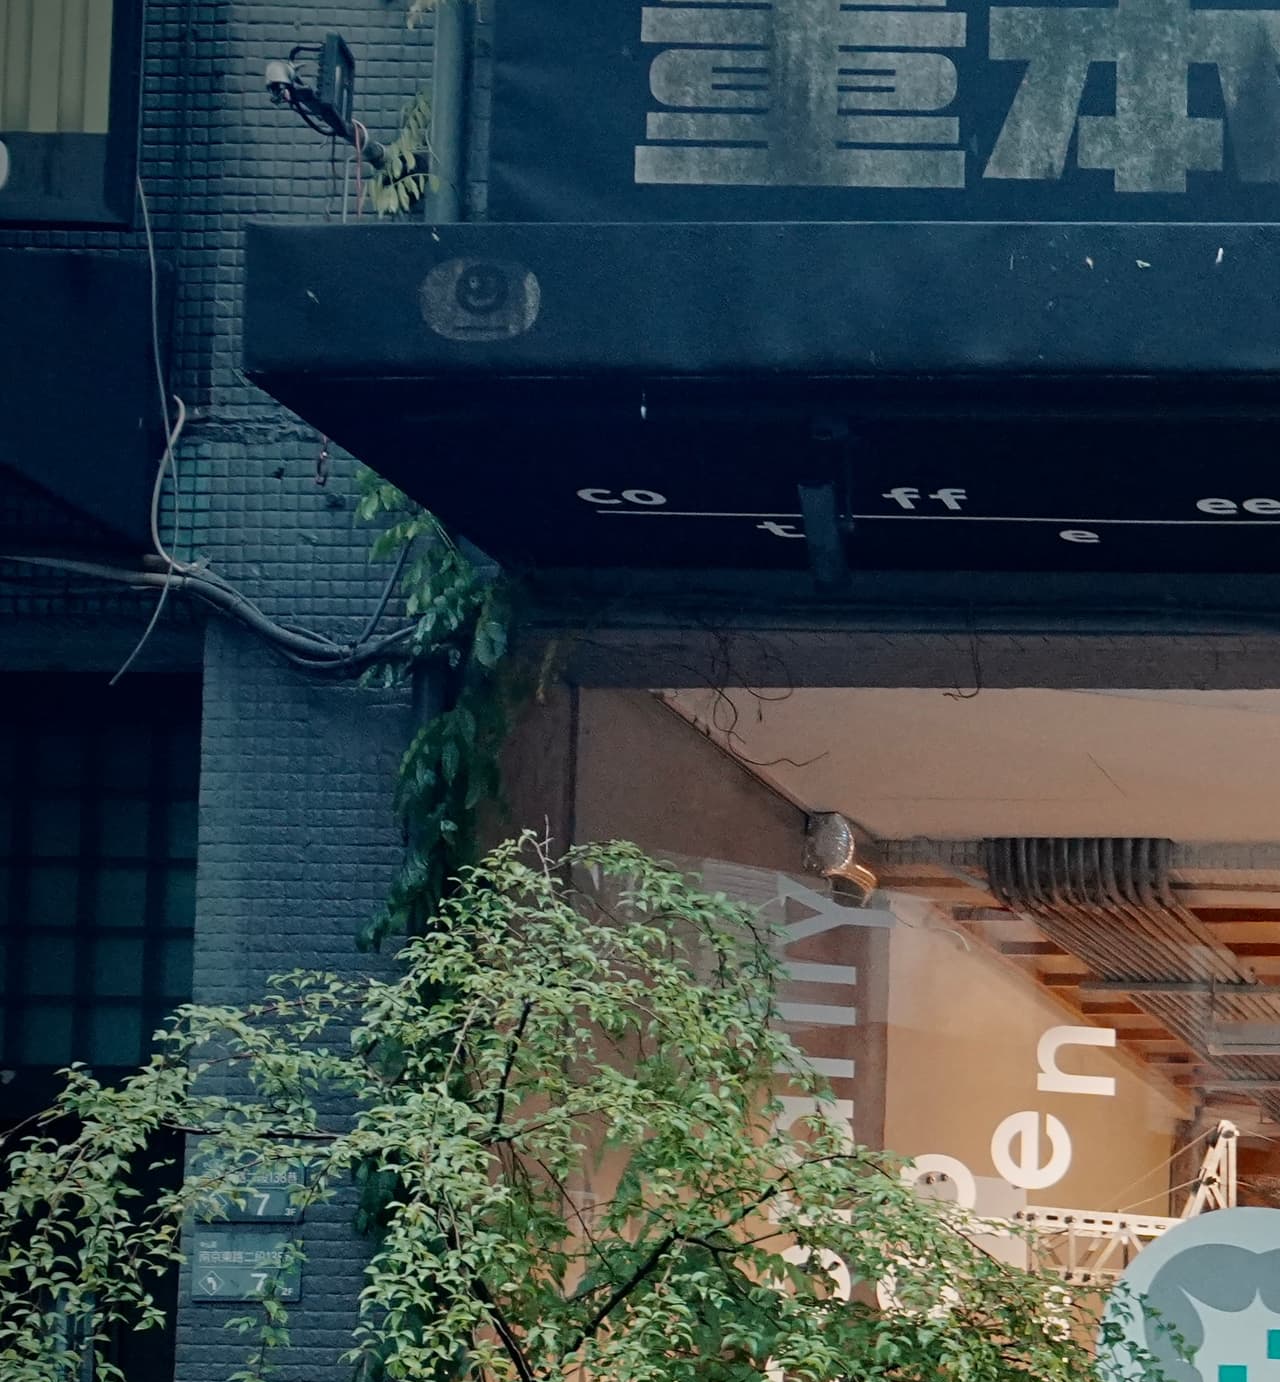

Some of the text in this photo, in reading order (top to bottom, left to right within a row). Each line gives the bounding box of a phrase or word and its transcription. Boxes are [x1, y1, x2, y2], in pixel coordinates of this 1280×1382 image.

[576, 487, 667, 505] co
[881, 486, 968, 511] ff
[1059, 528, 1100, 543] e
